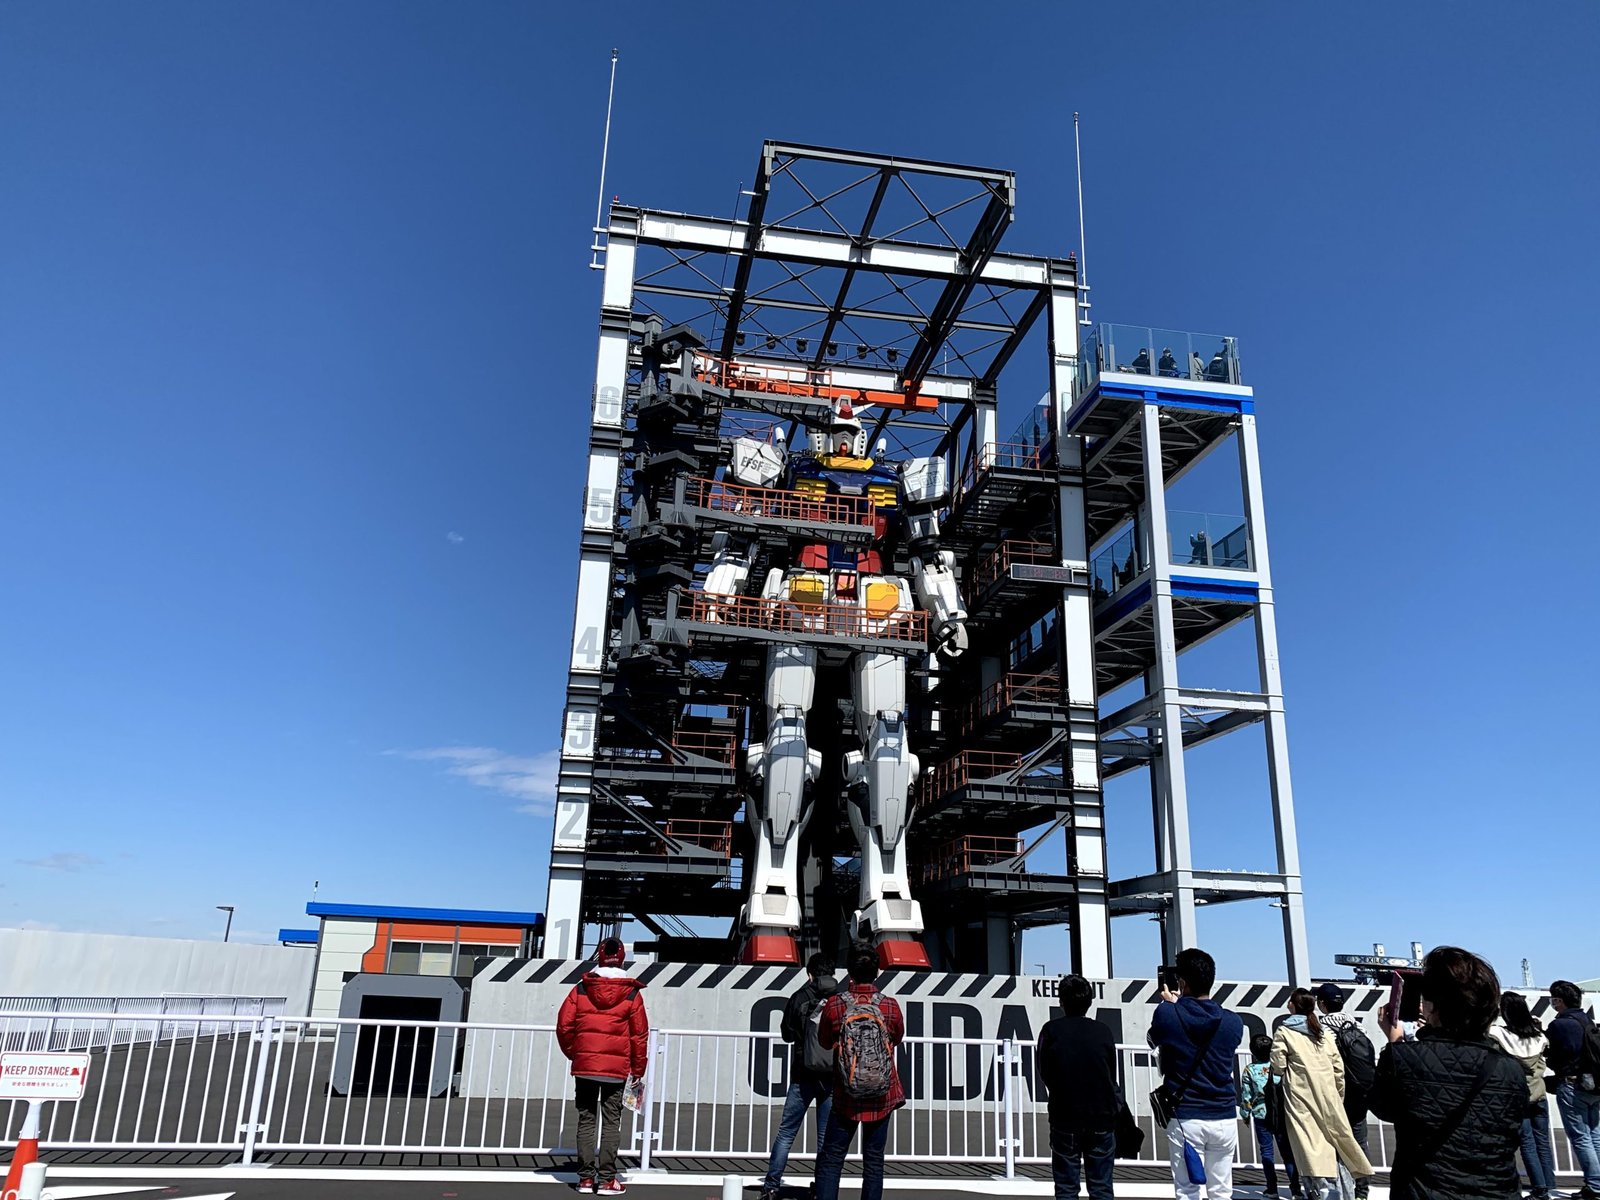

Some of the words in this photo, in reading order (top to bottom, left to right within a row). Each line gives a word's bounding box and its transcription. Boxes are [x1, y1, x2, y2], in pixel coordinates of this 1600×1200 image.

[740, 456, 764, 471] EFSF
[590, 487, 612, 523] 5
[575, 626, 600, 664] 4
[568, 709, 593, 749] 3
[558, 798, 585, 840] 2
[554, 918, 571, 959] 1
[1032, 979, 1060, 998] KEE
[4, 1065, 26, 1075] KEEP
[28, 1065, 70, 1076] DISTANCE
